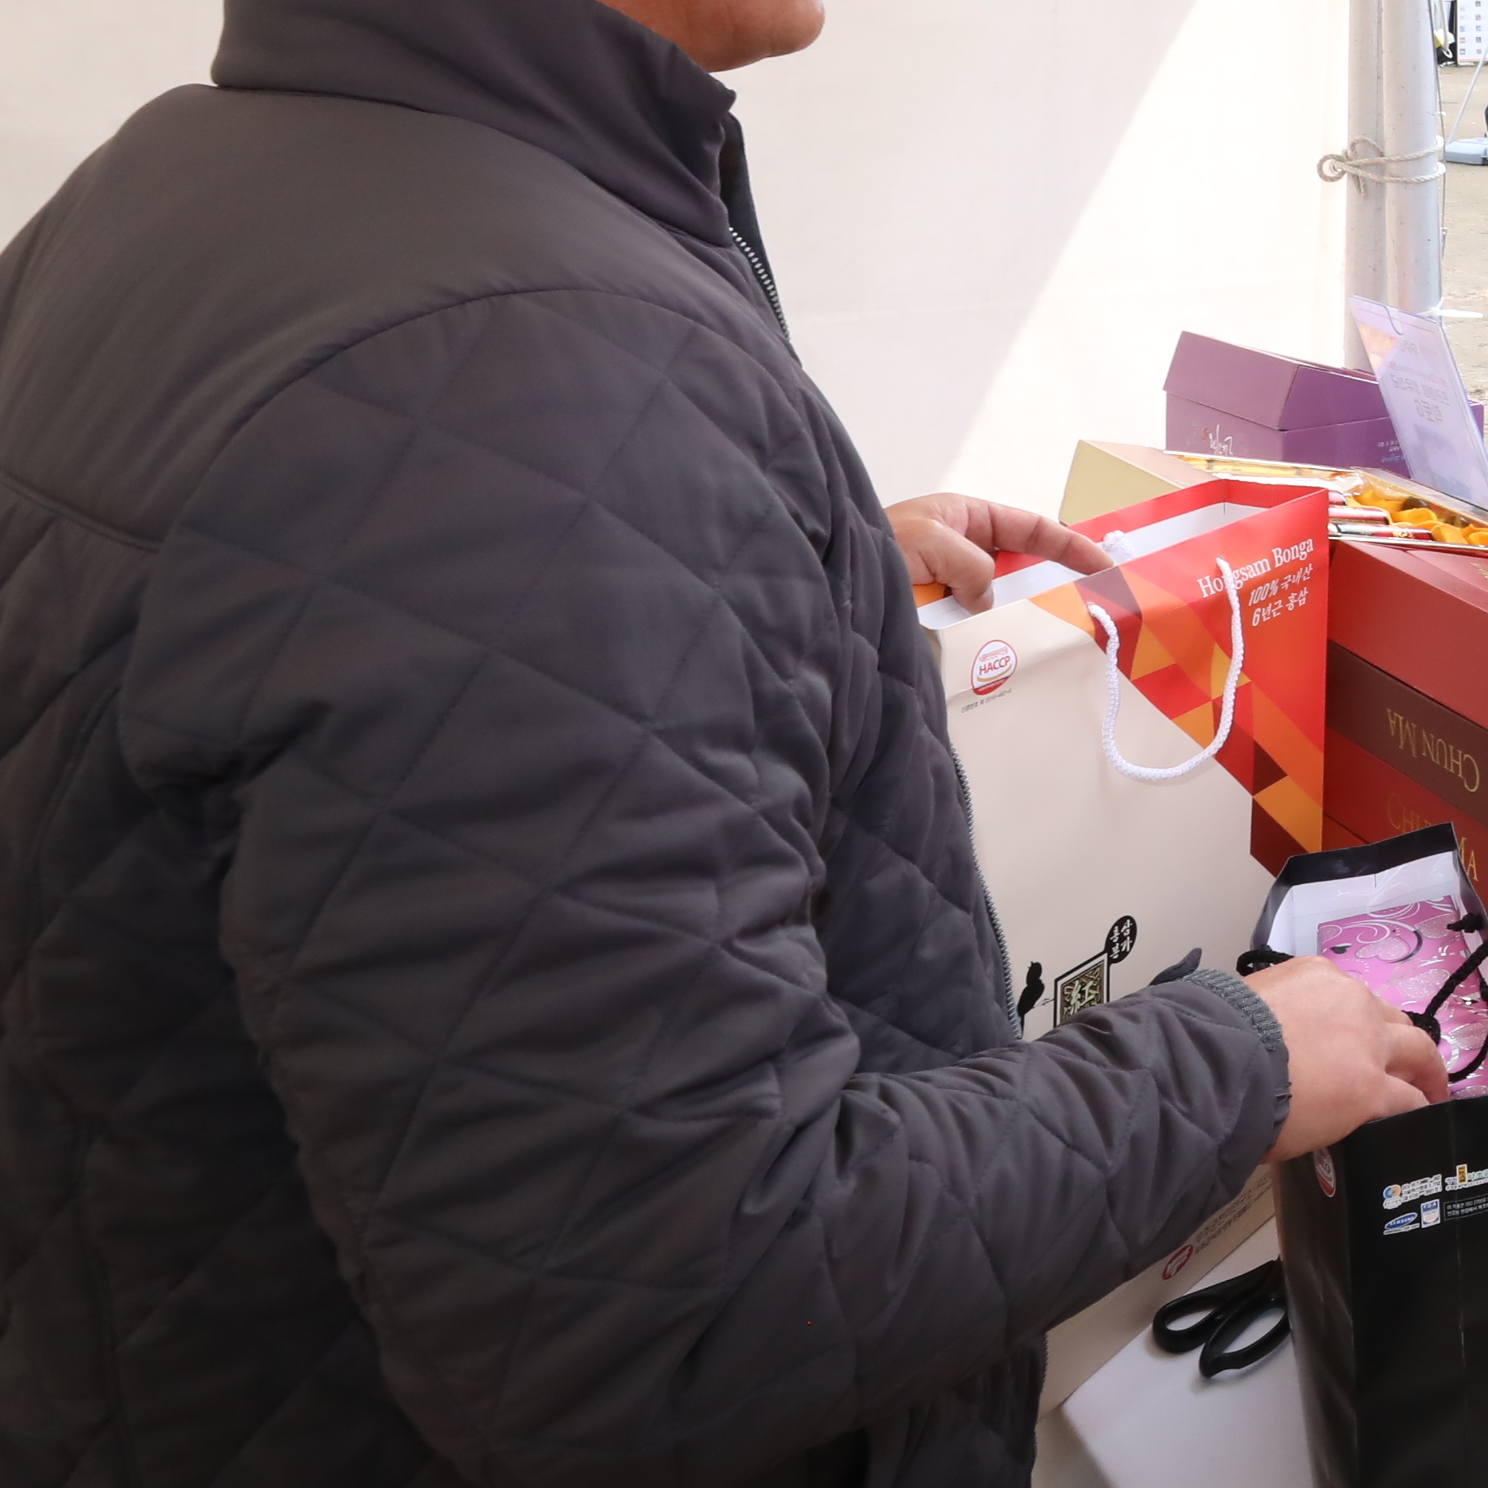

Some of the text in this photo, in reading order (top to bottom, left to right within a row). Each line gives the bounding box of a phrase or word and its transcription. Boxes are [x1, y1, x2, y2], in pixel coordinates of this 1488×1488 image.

[1272, 538, 1314, 568] Bonga
[1248, 563, 1313, 606] 100% 국내산
[1252, 587, 1308, 627] 6년근 홍삼
[979, 655, 1011, 675] HACCP
[1386, 708, 1480, 792] CHUN MA
